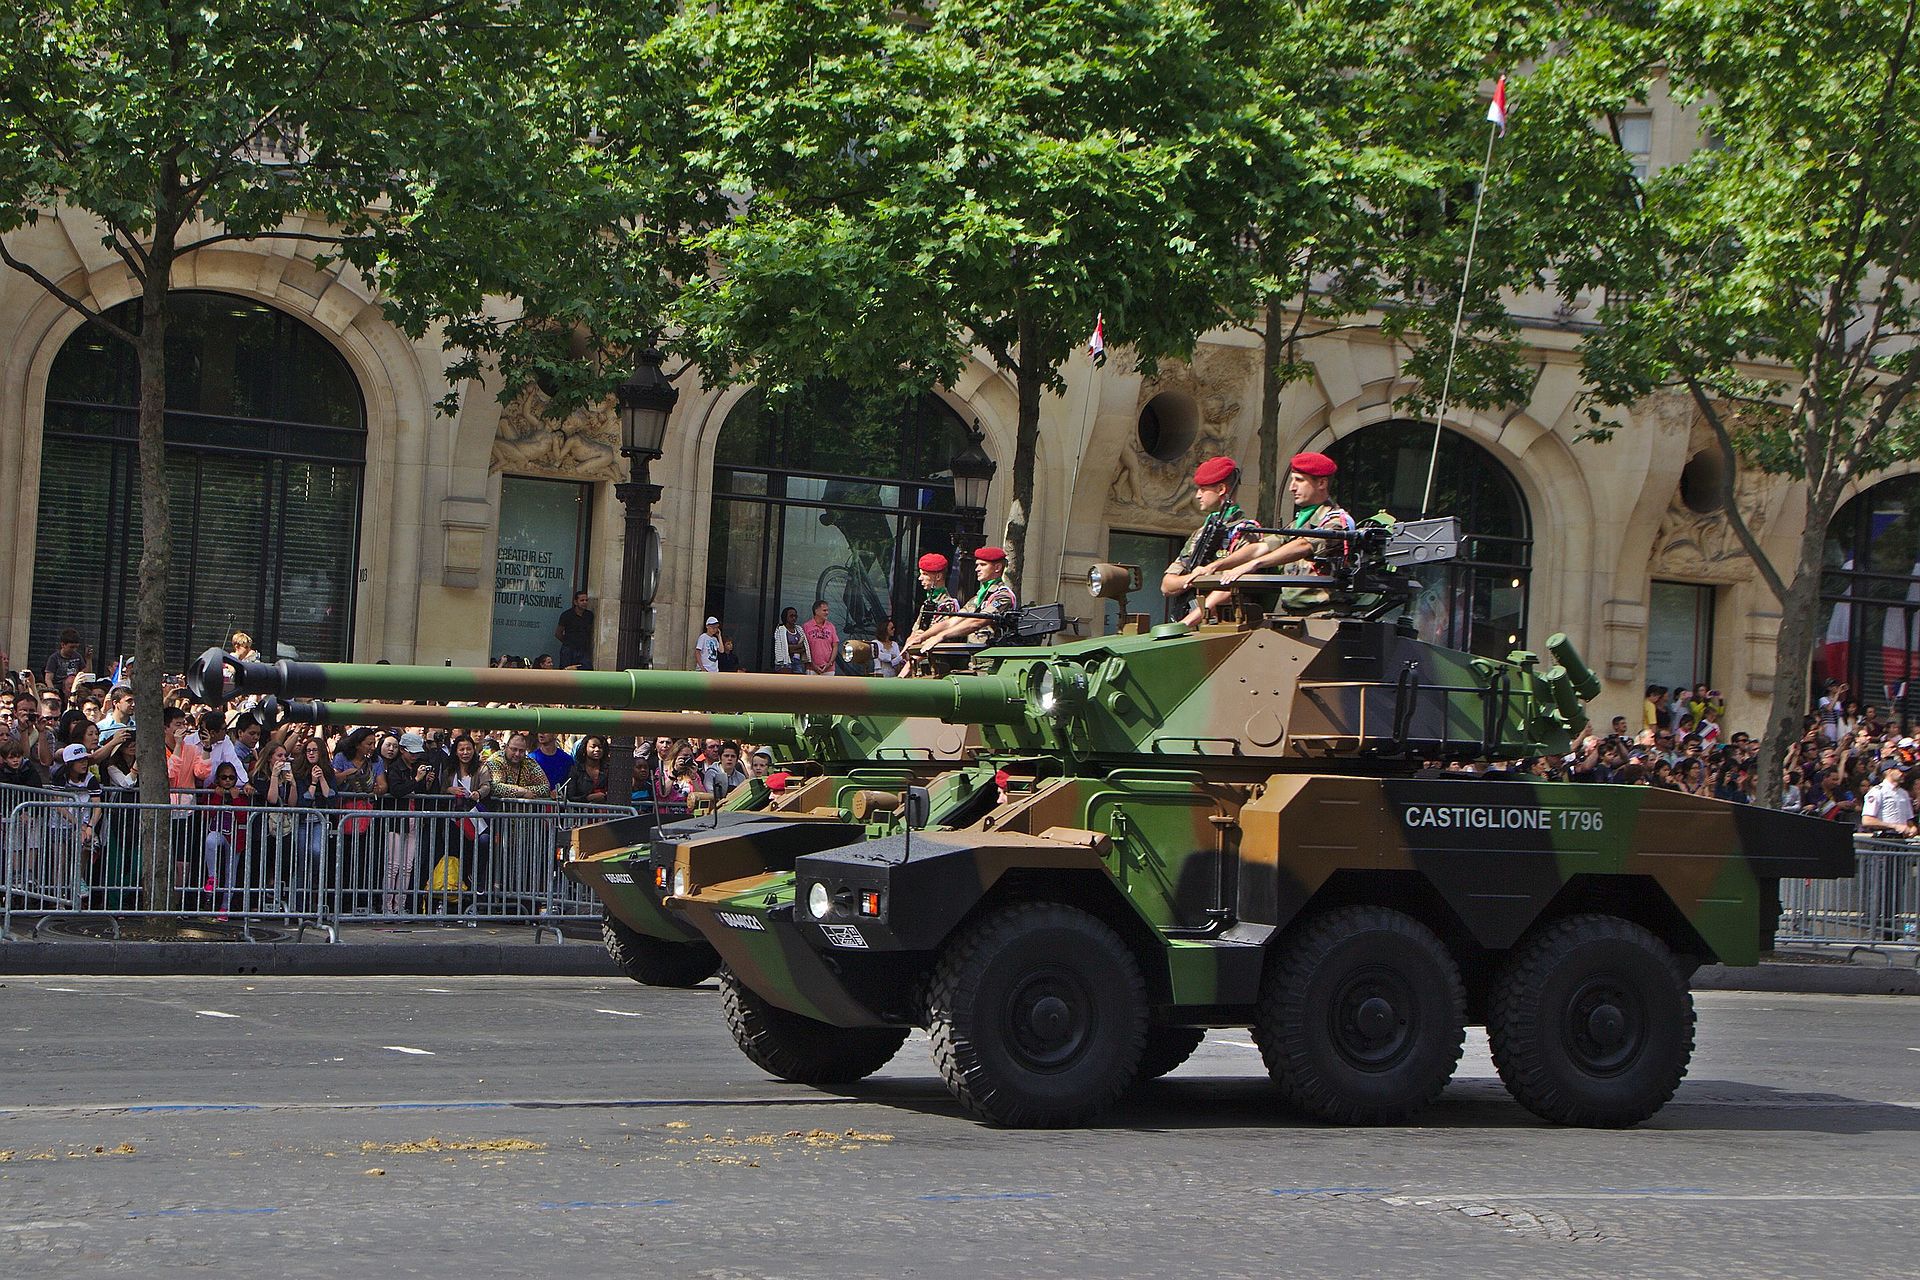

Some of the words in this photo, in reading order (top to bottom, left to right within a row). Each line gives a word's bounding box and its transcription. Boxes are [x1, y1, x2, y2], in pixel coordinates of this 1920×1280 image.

[538, 551, 553, 564] EST
[1405, 806, 1552, 830] CASTIGLIONE
[1558, 811, 1604, 831] 1796
